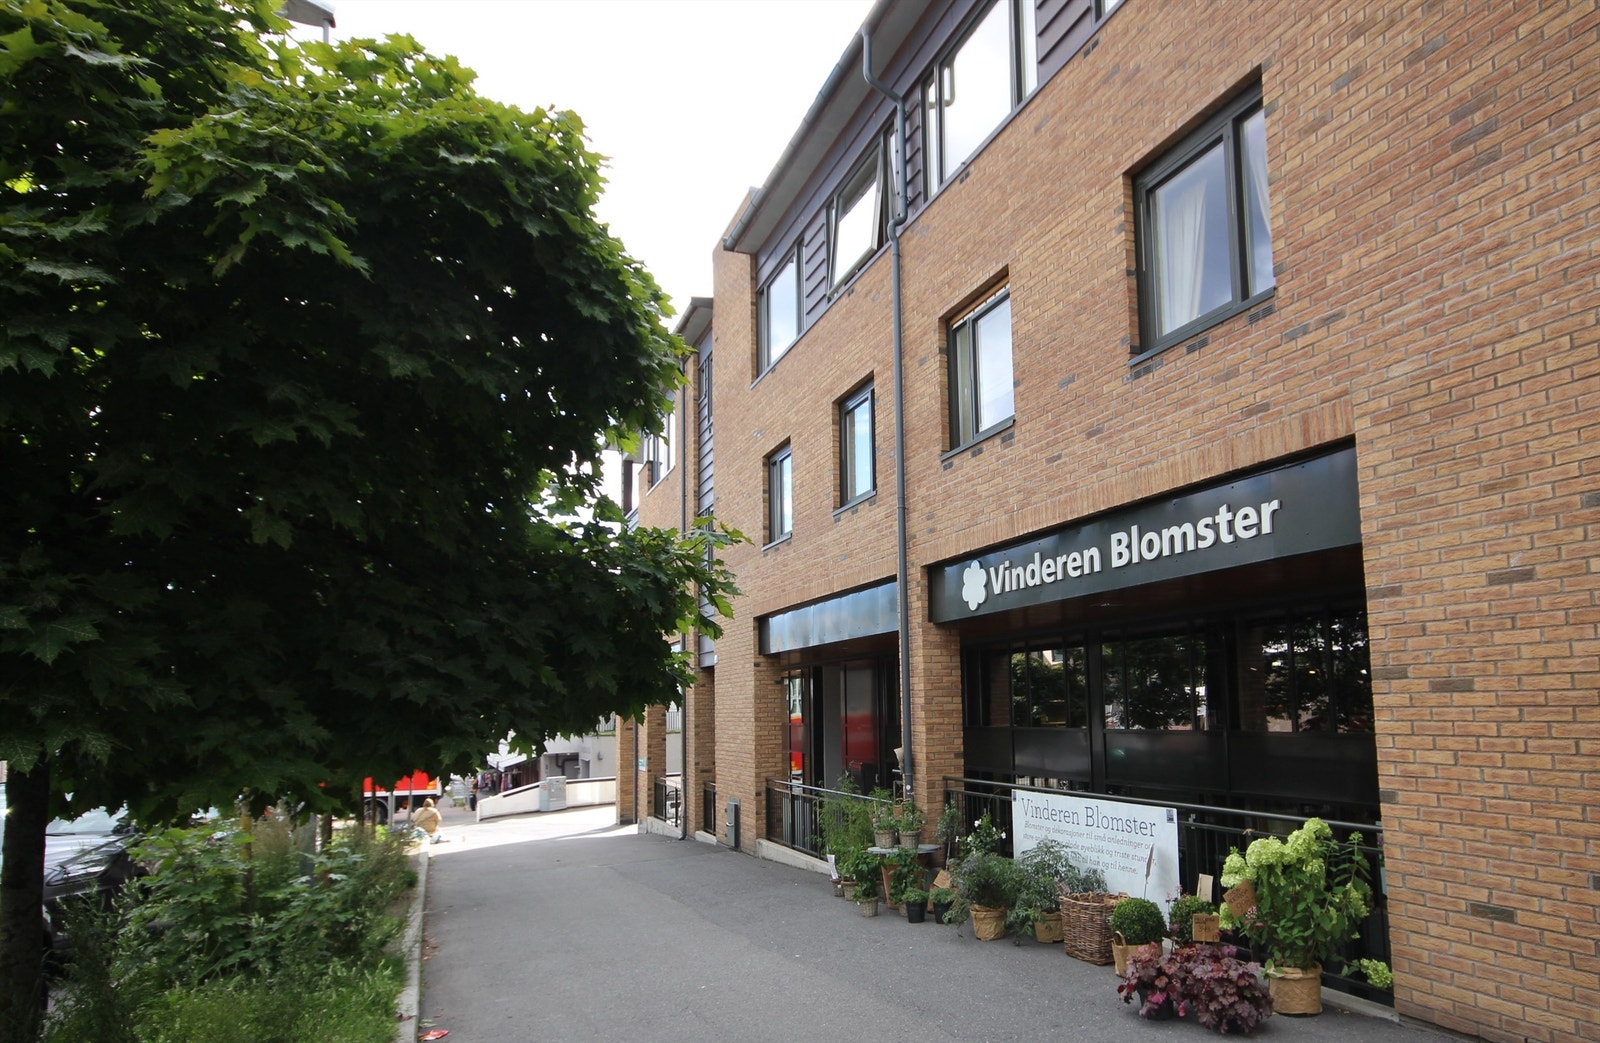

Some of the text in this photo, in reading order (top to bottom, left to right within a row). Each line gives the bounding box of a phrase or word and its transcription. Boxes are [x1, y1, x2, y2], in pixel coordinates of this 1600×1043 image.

[990, 499, 1281, 596] Vinderen Blomster
[1021, 798, 1080, 825] Vinderen
[1085, 806, 1156, 837] Blomster
[1024, 820, 1044, 831] Blomster
[1052, 824, 1085, 838] dekorasjoner
[1107, 835, 1144, 849] anledninger
[1080, 843, 1104, 855] øyeblikk
[1105, 849, 1114, 858] og
[1114, 850, 1130, 860] triste
[1131, 853, 1157, 867] stundr,
[1101, 861, 1110, 870] og
[1110, 860, 1118, 869] til
[1118, 861, 1138, 875] henne.
